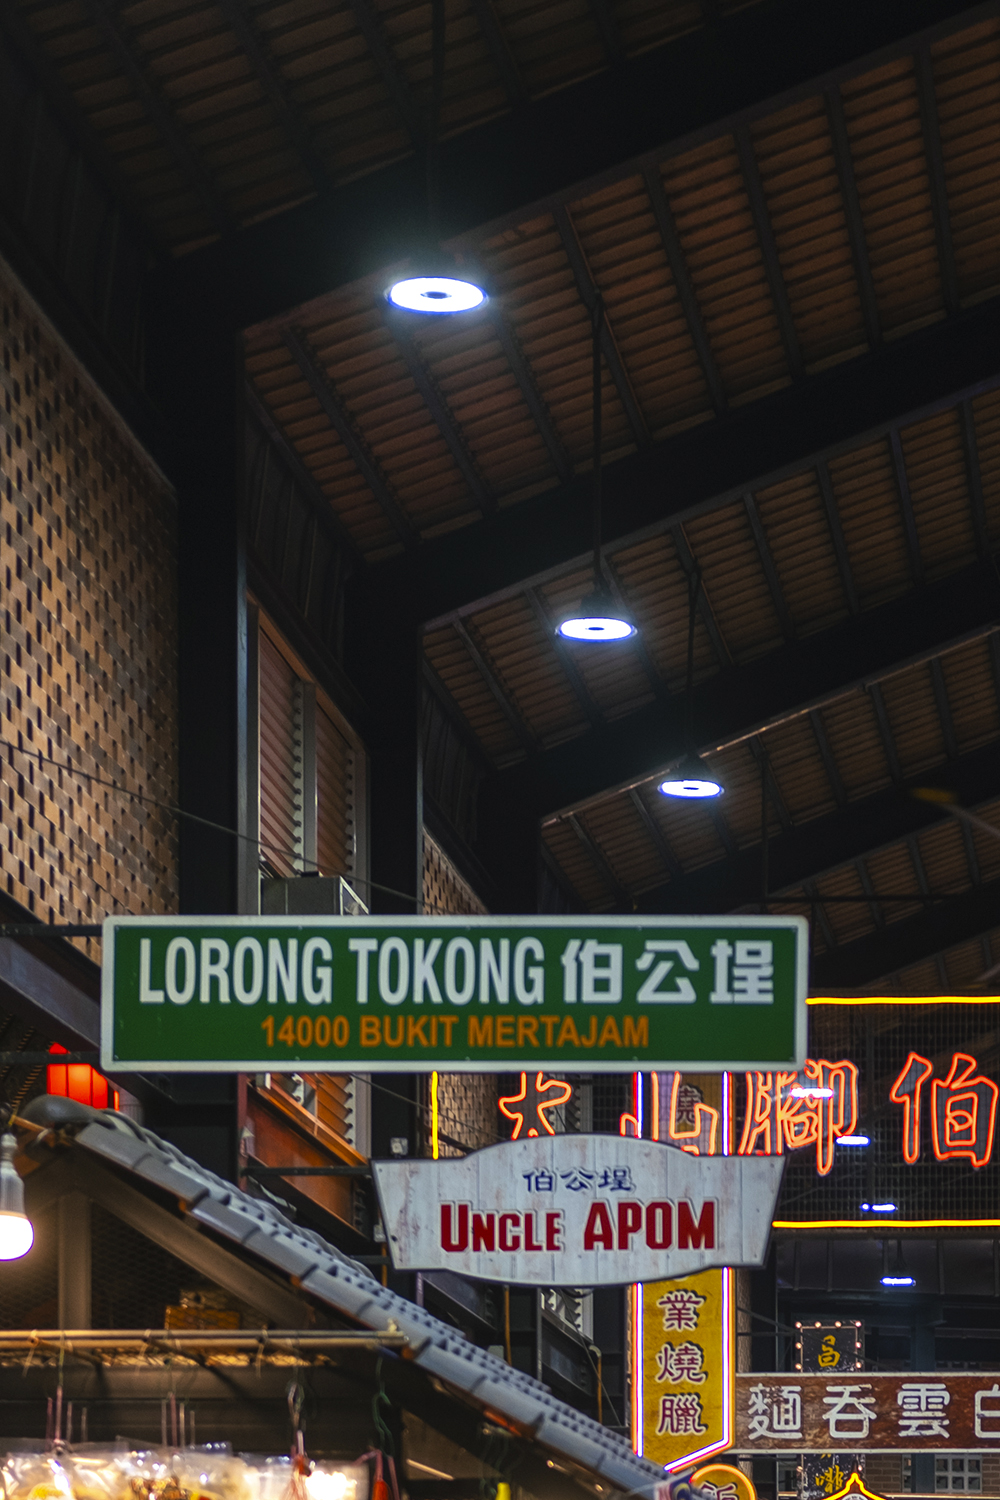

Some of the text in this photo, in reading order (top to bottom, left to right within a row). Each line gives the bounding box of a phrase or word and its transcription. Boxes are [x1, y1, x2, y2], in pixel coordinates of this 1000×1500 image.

[138, 937, 775, 1005] LORONG TOKONG 伯公埕
[261, 1015, 650, 1048] 14000 BUKIT MERTAJAM
[522, 1166, 633, 1193] 伯公埕
[584, 1201, 716, 1251] APOM
